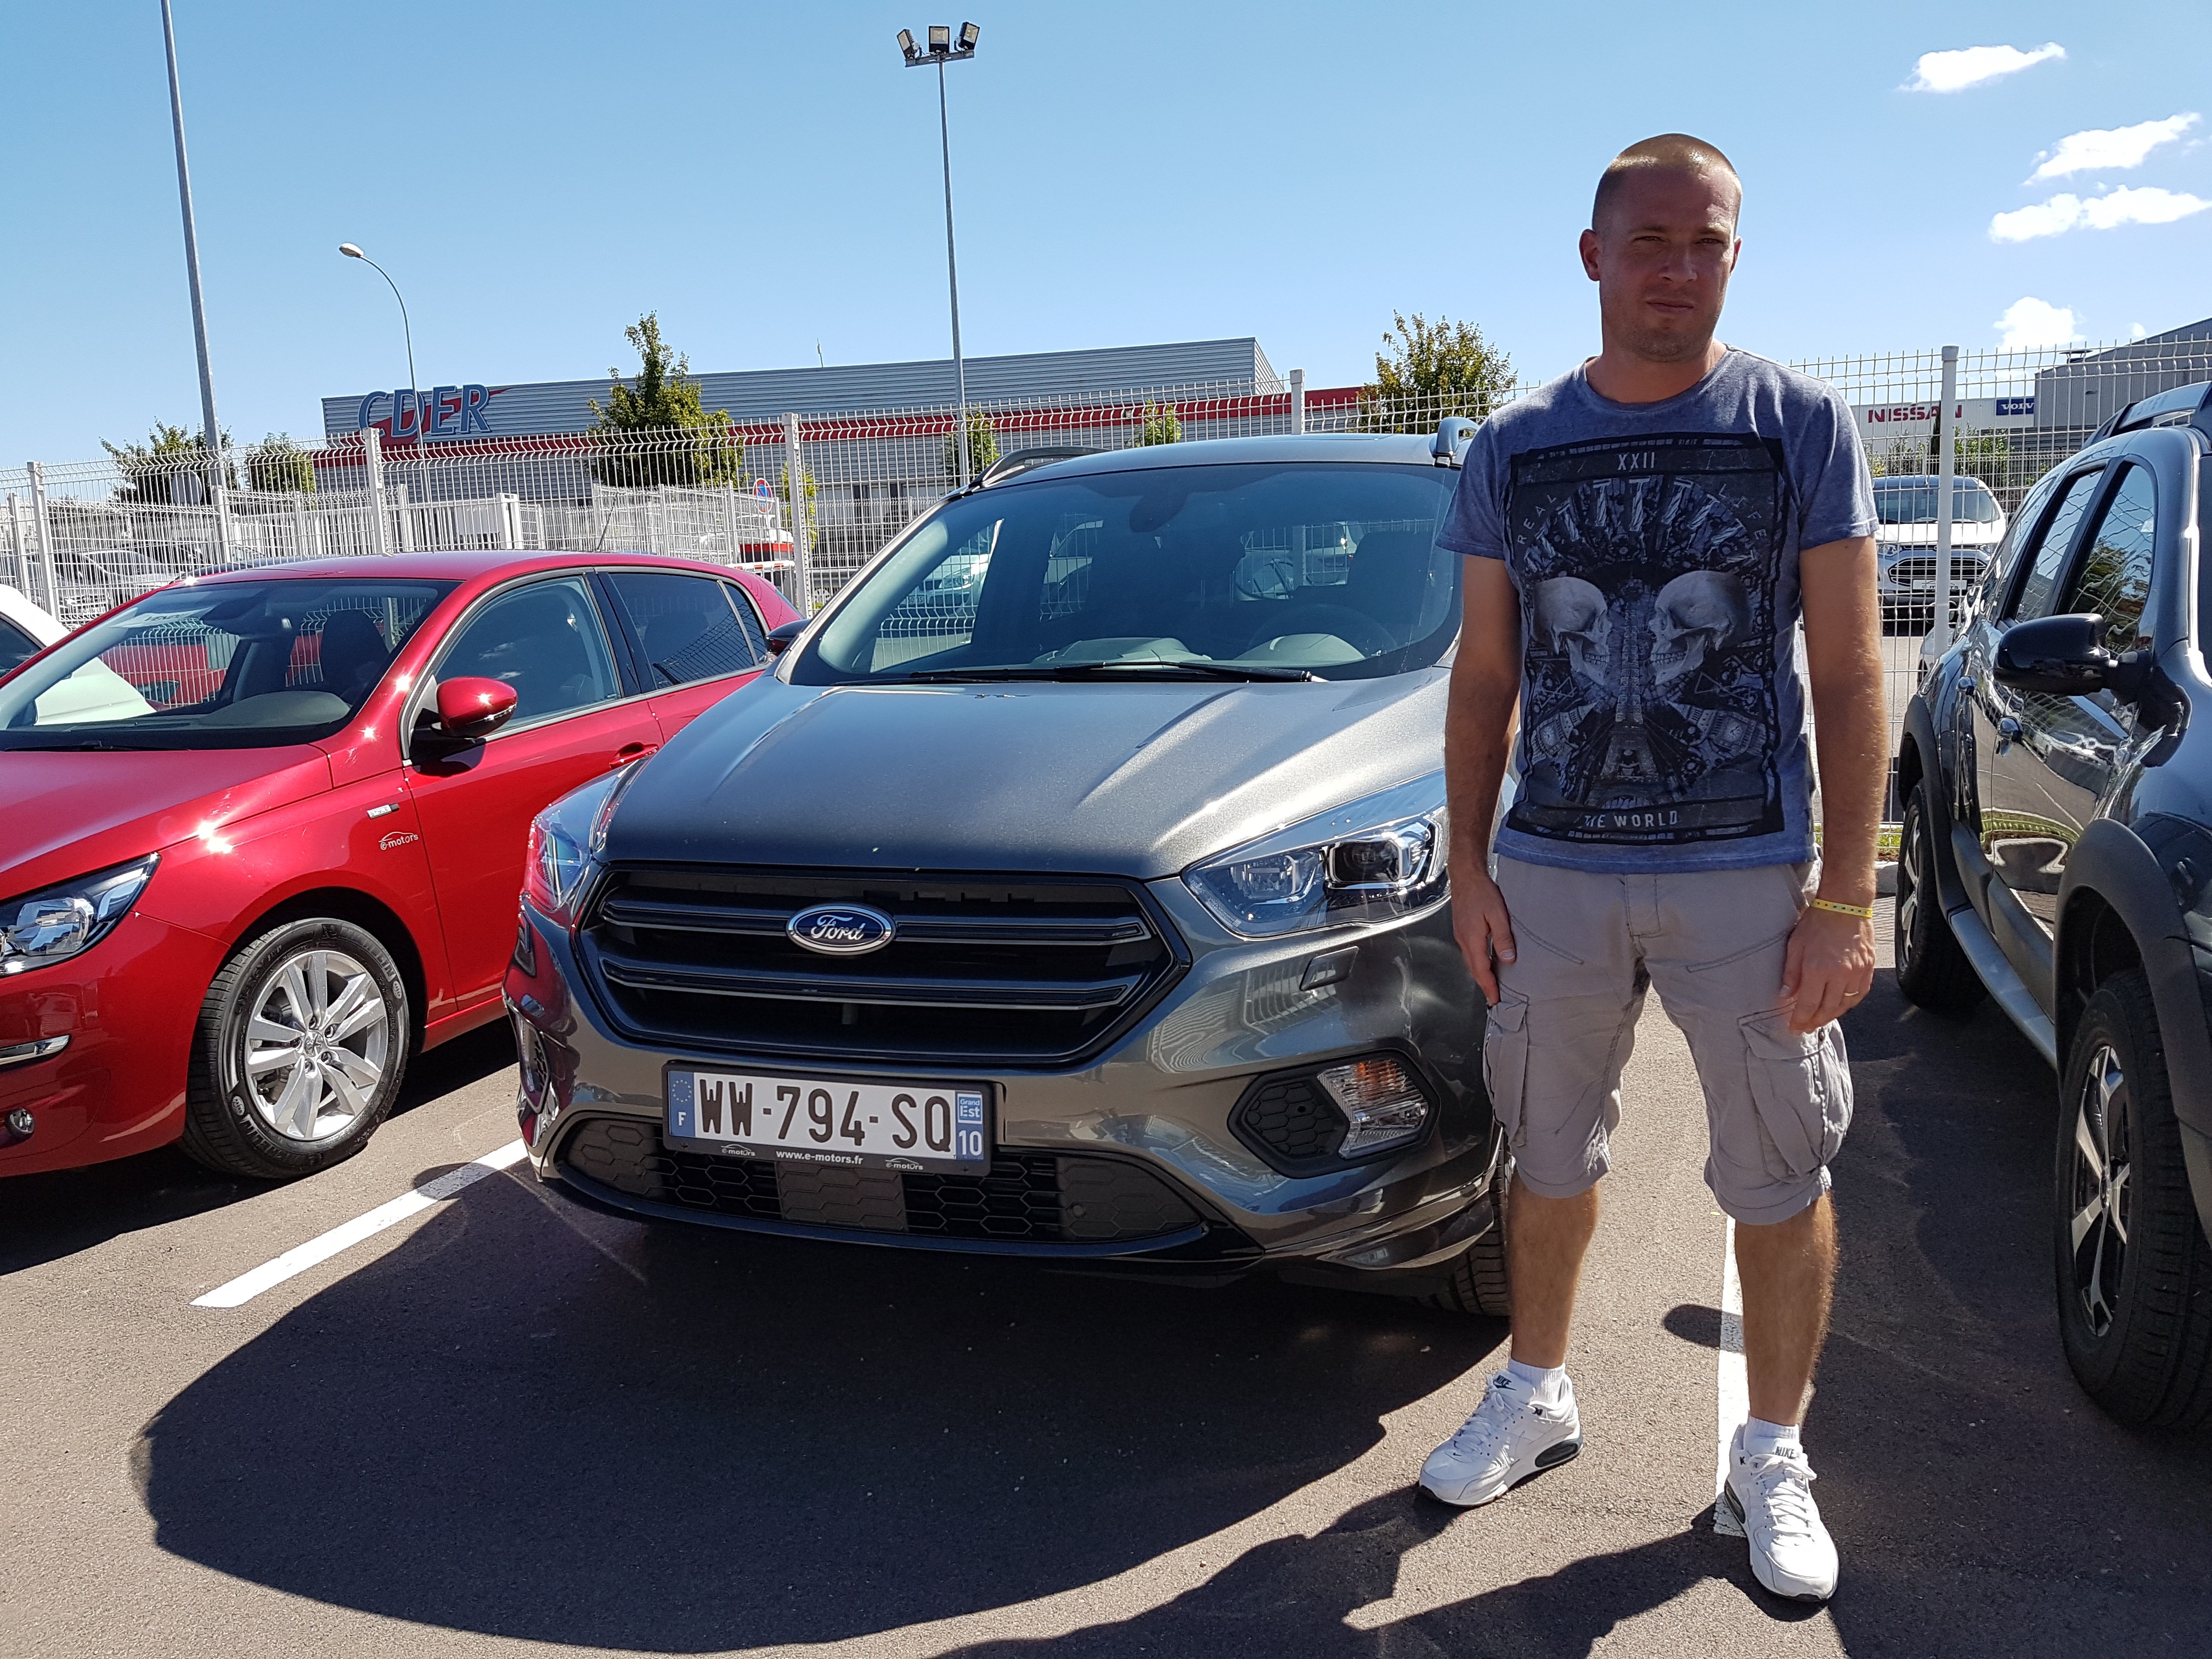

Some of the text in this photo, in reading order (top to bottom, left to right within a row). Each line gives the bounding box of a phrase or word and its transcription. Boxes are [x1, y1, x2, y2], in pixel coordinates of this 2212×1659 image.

[358, 384, 491, 437] CDER
[1617, 452, 1655, 471] XXII
[1517, 494, 1556, 544] REAL
[1614, 810, 1677, 827] WORLD
[380, 833, 419, 850] e-motors
[811, 915, 866, 940] Ford
[678, 1111, 686, 1126] F
[960, 1105, 980, 1118] Est
[959, 1130, 982, 1156] 10
[776, 1151, 864, 1164] www.e-motors.fr
[1495, 1374, 1512, 1387] NIKE
[1775, 1446, 1796, 1459] NIKE
